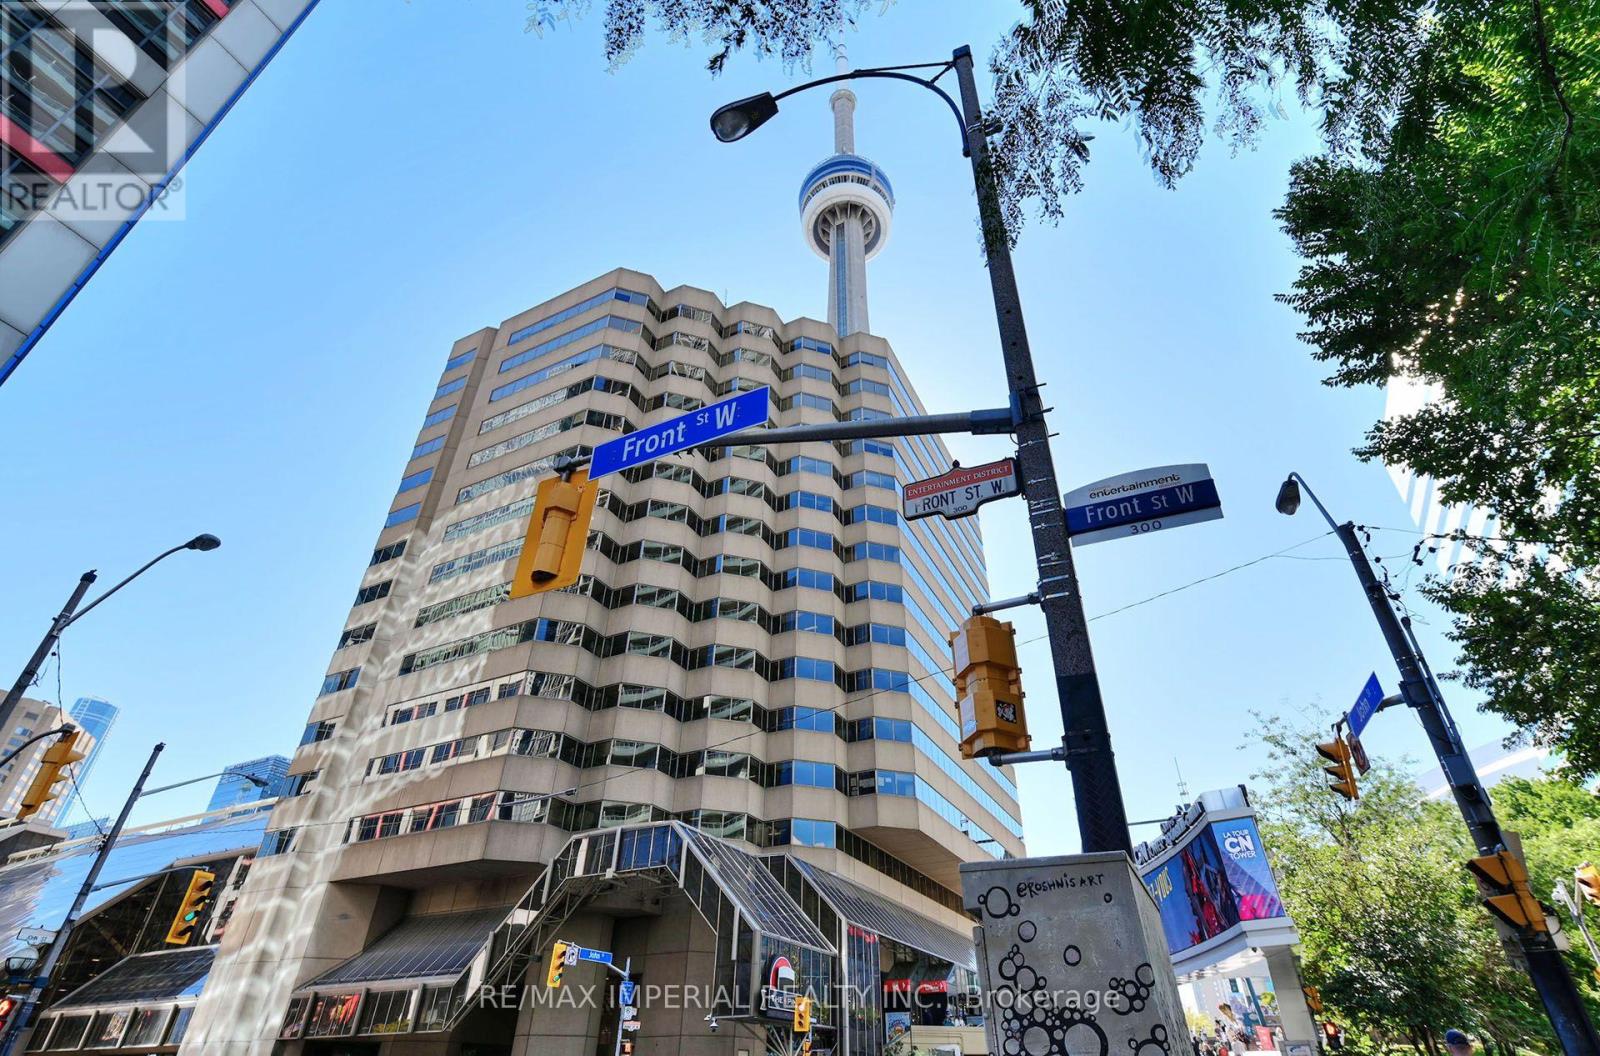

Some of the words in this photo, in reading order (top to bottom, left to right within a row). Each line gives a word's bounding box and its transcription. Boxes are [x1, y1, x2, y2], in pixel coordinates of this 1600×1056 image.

[621, 421, 686, 462] Front
[696, 411, 710, 427] St
[715, 401, 737, 430] W
[907, 473, 972, 497] ENTERTAINMENT
[973, 465, 1009, 479] DISTRICT
[965, 484, 984, 501] ST.
[991, 479, 1006, 493] W.
[1088, 473, 1181, 500] entertainment
[1085, 498, 1142, 524] Front
[1151, 495, 1169, 510] St
[1175, 484, 1194, 505] W
[1130, 520, 1162, 535] 300
[1224, 836, 1255, 853] CN
[1229, 851, 1257, 861] TOWER
[1079, 873, 1104, 887] ART
